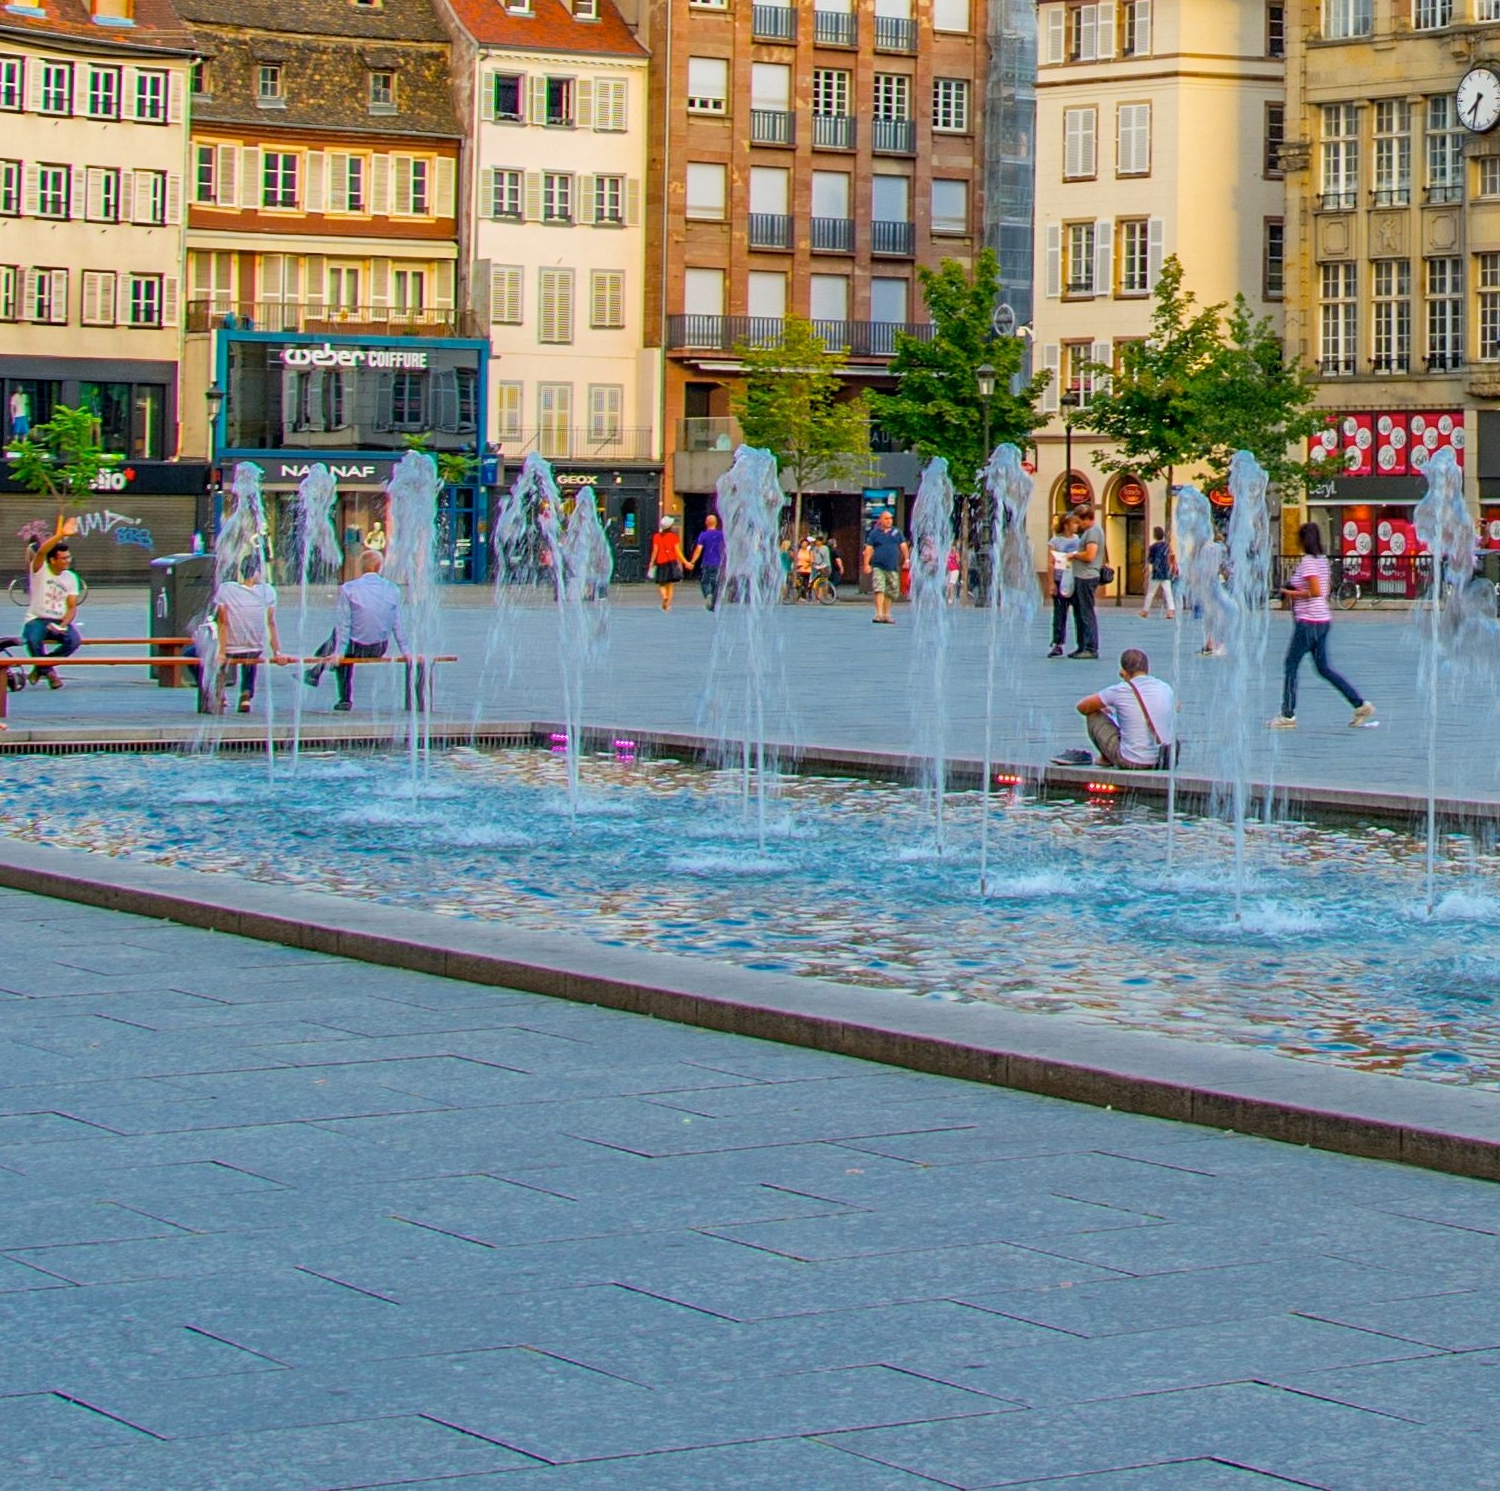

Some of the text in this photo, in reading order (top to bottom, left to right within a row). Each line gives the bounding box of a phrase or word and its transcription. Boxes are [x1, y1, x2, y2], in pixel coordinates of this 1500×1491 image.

[283, 343, 428, 368] weber COIFFURE
[281, 465, 376, 478] NA NAF
[557, 475, 598, 485] GEOX
